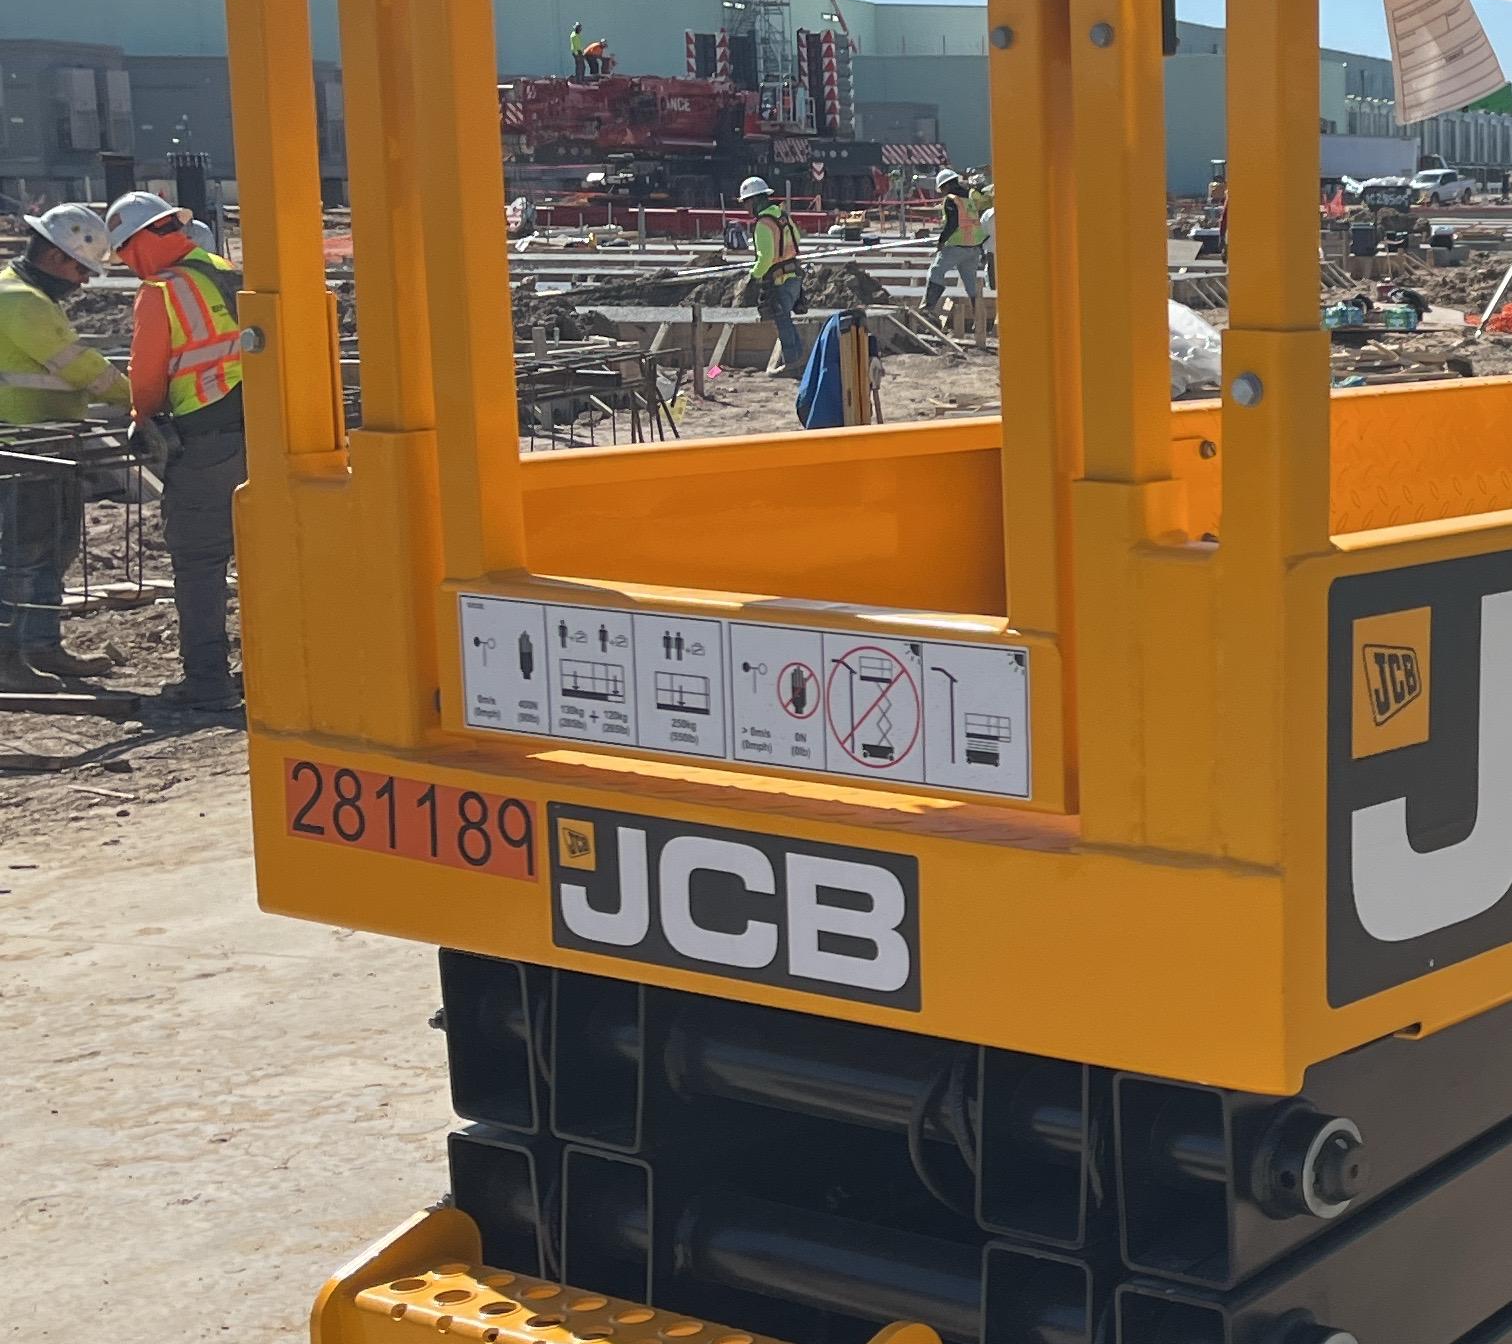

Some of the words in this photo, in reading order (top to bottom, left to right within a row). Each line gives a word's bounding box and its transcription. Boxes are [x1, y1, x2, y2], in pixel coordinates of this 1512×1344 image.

[1373, 650, 1419, 716] JCB
[291, 760, 536, 877] 281189
[560, 826, 911, 993] JCB
